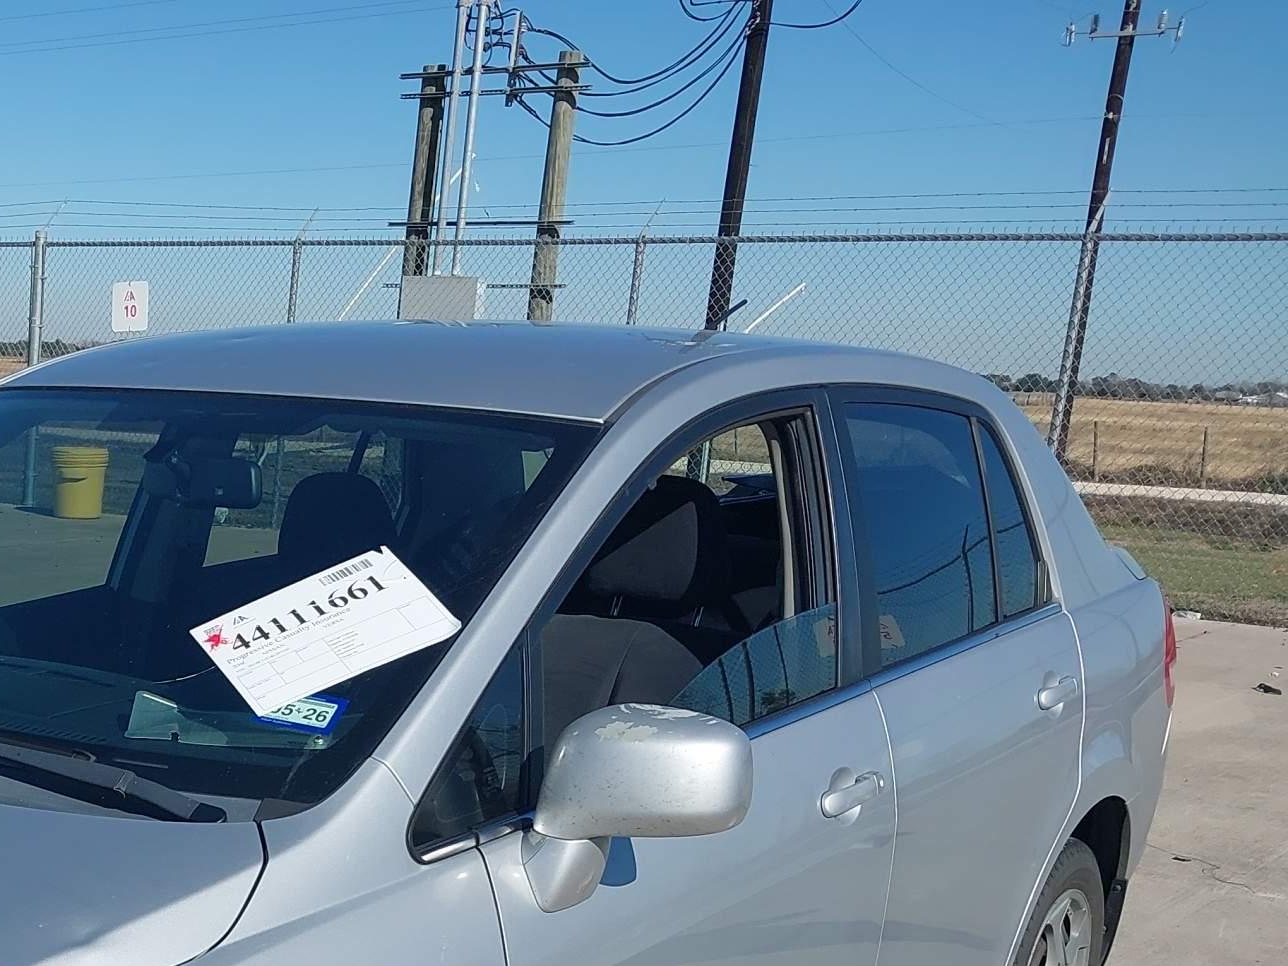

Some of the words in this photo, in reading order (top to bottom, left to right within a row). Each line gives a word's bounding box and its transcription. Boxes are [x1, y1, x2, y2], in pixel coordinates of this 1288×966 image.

[124, 305, 136, 317] 10
[232, 576, 390, 651] 44111661
[227, 641, 274, 664] Progressive
[275, 626, 312, 642] Casualty
[310, 606, 352, 627] Insurance
[303, 708, 329, 722] 26
